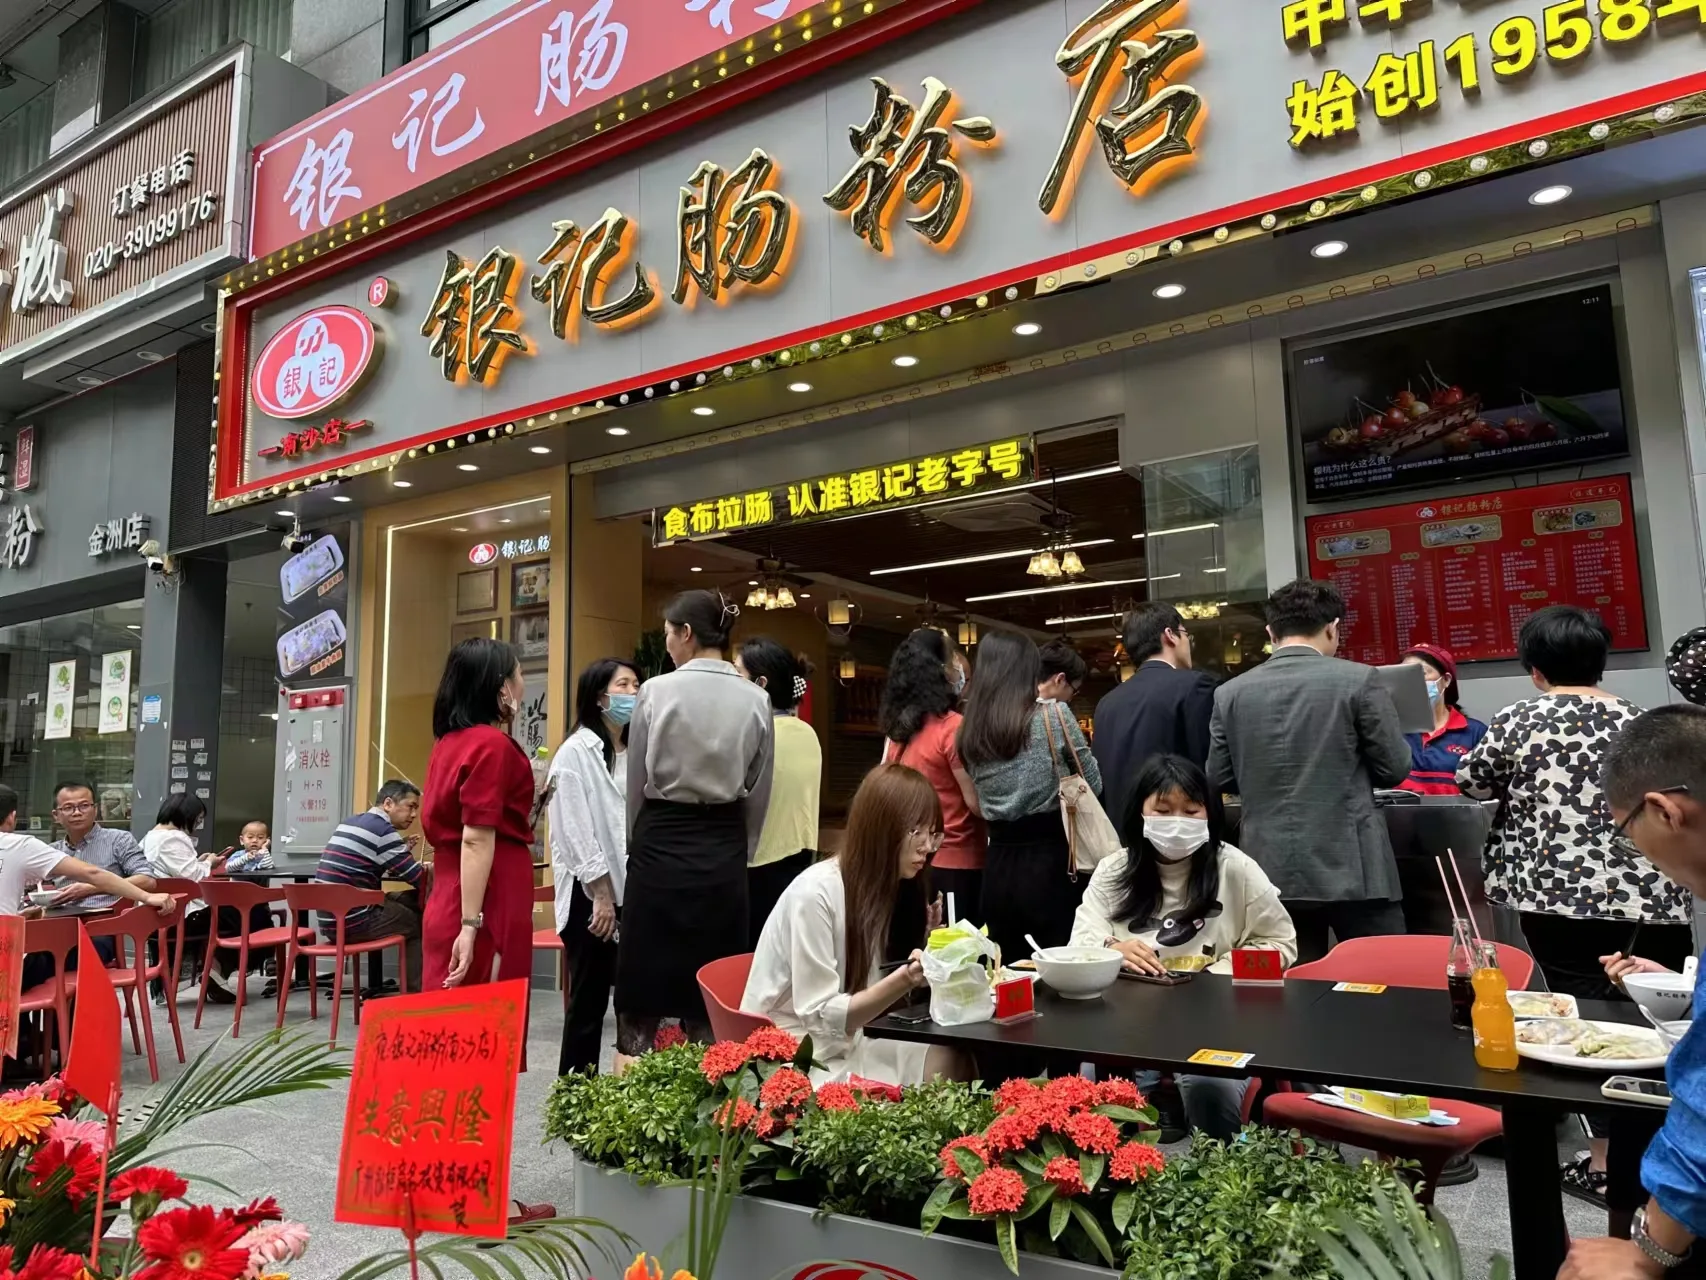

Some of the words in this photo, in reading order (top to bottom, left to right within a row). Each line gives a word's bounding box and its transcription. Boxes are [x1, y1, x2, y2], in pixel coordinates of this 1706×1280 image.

[283, 0, 790, 231] 银记肠
[111, 148, 195, 219] 订餐电话
[419, 0, 1200, 384] 银记肠粉店
[84, 189, 216, 279] 020-39099176
[280, 417, 347, 458] 南沙店
[663, 489, 774, 541] 食布拉肠
[786, 440, 1024, 518] 认准银记老字号
[87, 511, 148, 558] 金洲店
[299, 747, 331, 770] 消火栓
